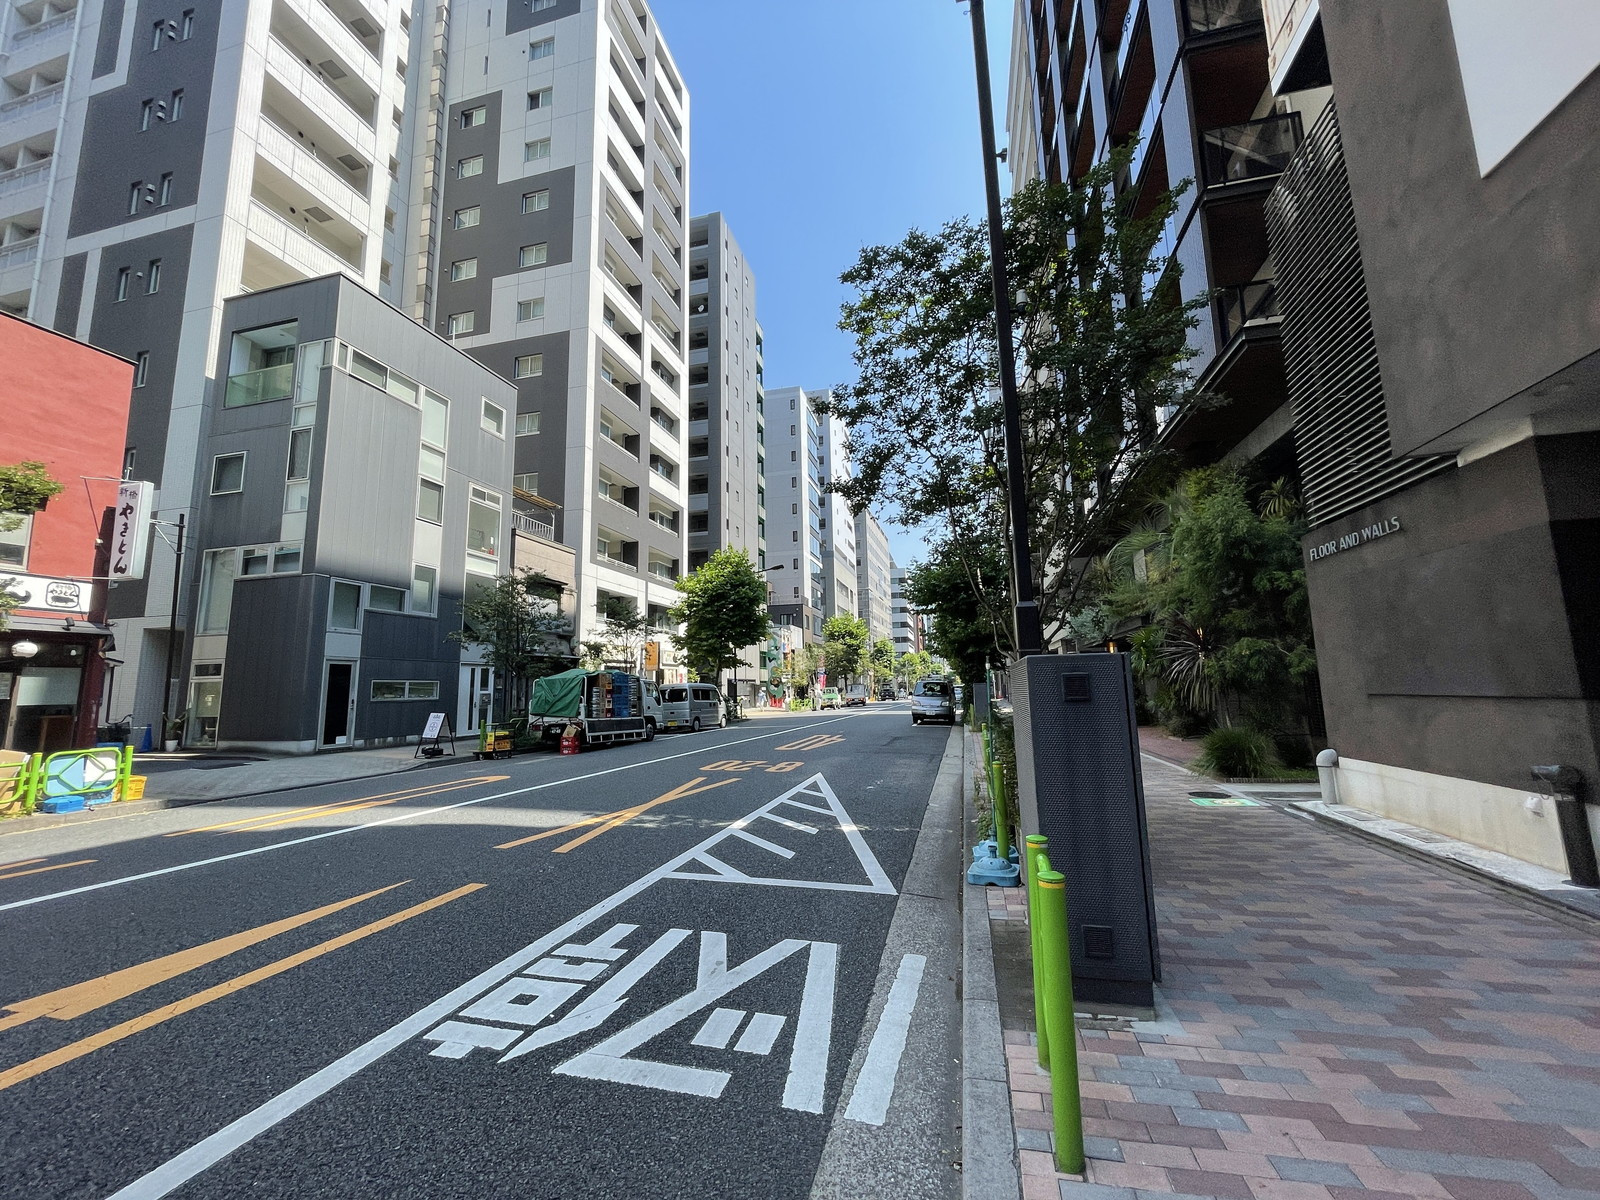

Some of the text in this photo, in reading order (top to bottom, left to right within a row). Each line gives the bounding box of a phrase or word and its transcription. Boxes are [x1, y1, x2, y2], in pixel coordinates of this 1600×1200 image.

[113, 502, 134, 575] やきとん
[1309, 516, 1400, 561] FLOOR AND WALLS
[774, 733, 846, 751] 40
[699, 759, 805, 773] 8-20
[422, 923, 927, 1126] バス停
